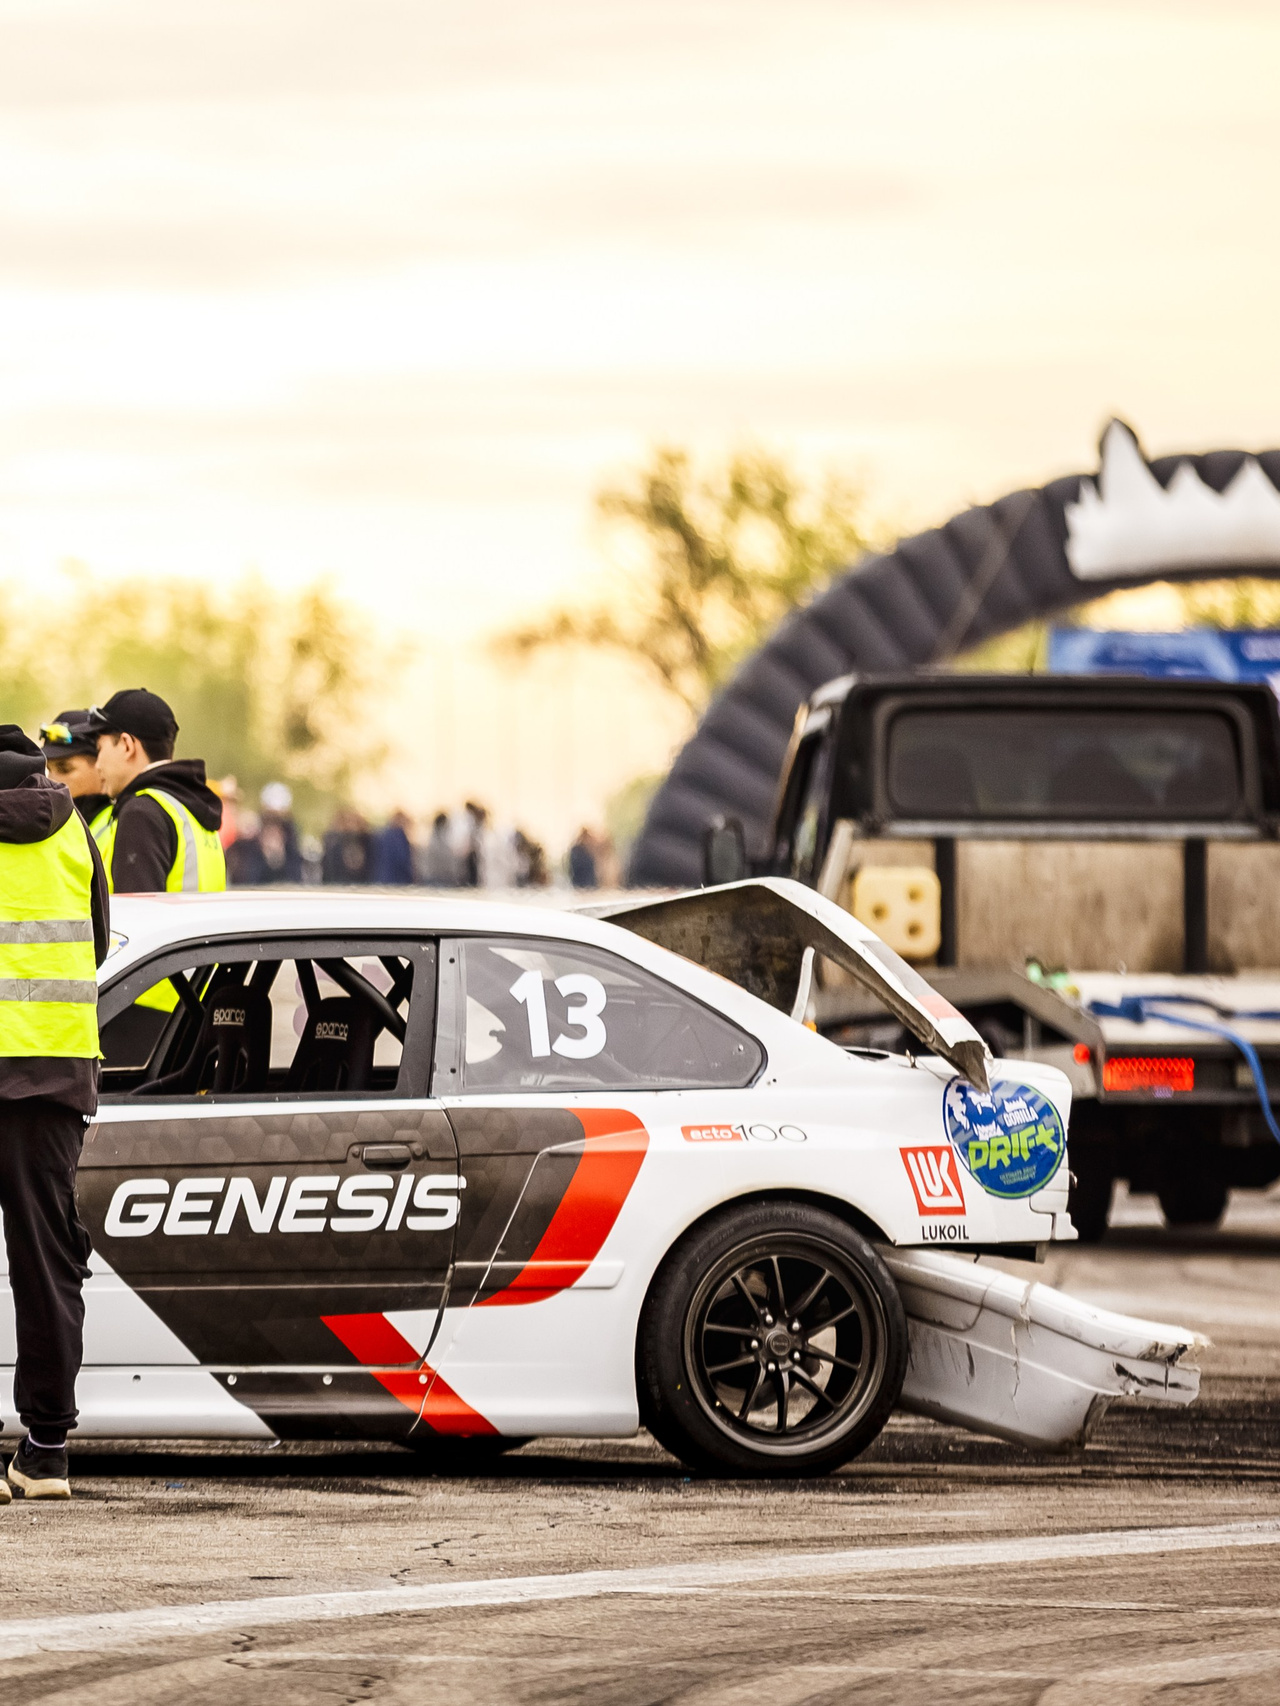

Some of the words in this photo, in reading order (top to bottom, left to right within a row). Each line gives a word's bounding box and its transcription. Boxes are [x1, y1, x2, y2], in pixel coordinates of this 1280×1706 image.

[213, 1008, 246, 1022] sparco
[509, 969, 608, 1060] 13
[315, 1022, 349, 1037] sparco
[1003, 1106, 1039, 1128] GORILLA
[968, 1124, 1058, 1171] DRIFT
[104, 1174, 467, 1238] GENESIS
[921, 1224, 969, 1240] LUKOIL
